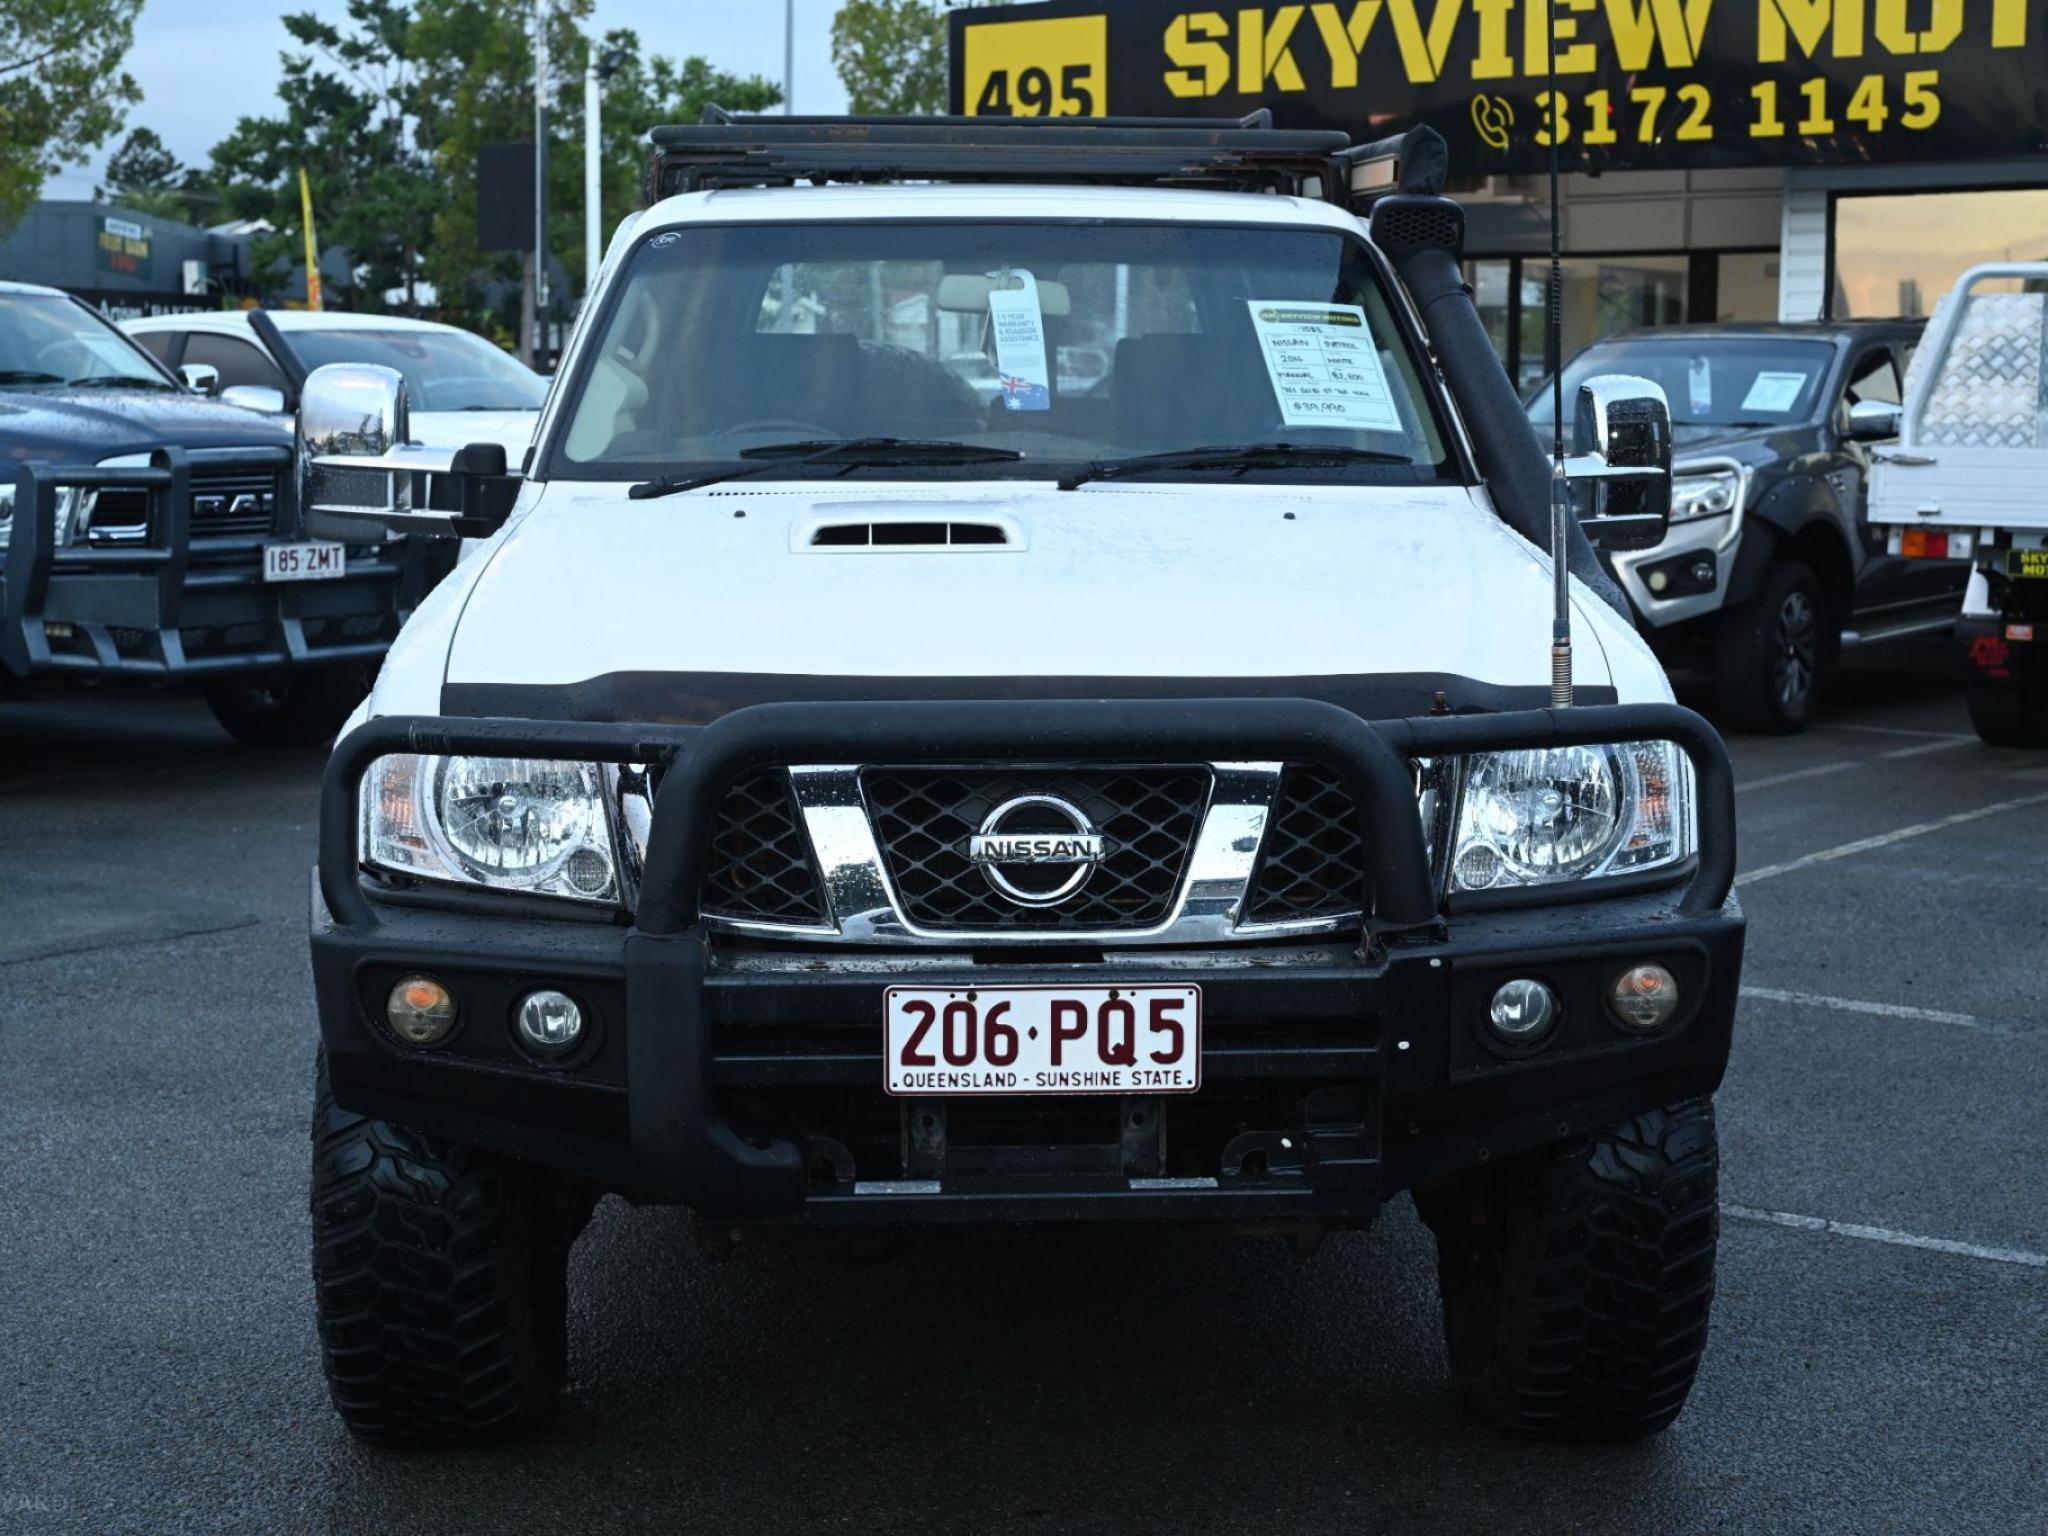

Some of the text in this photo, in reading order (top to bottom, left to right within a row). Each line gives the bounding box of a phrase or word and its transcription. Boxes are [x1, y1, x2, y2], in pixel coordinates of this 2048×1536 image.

[1164, 0, 1712, 97] SKYVIEW
[976, 64, 1093, 117] 495
[1534, 70, 1941, 145] 3172 1145
[1272, 339, 1310, 347] NISSAN
[194, 494, 273, 514] RA
[2022, 565, 2048, 576] MO
[984, 840, 1092, 858] NISSAN
[903, 1072, 1017, 1088] QUEENSLAND
[1036, 1071, 1121, 1087] SUNSHINE
[1131, 1070, 1182, 1086] STATE
